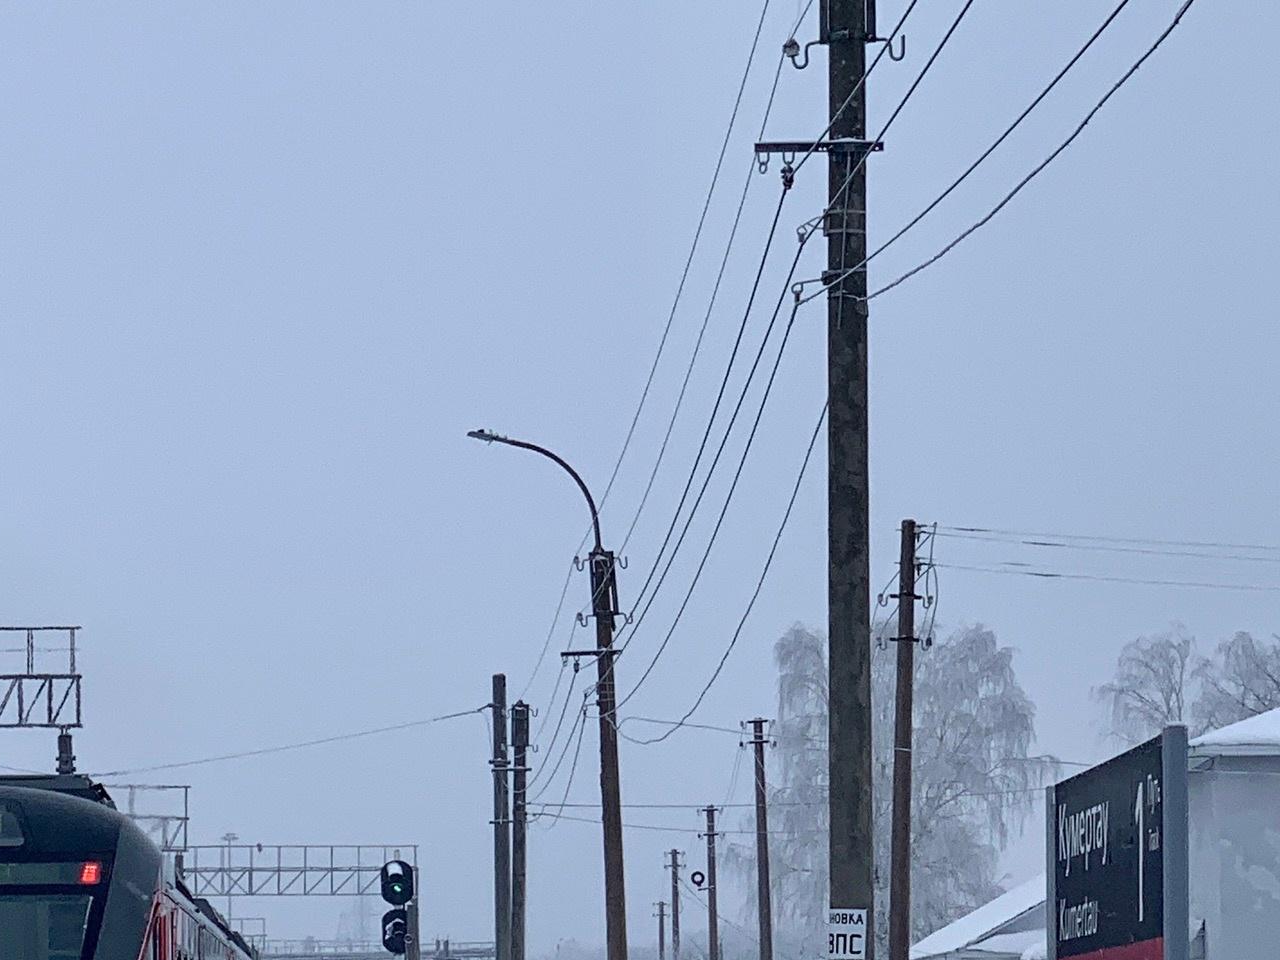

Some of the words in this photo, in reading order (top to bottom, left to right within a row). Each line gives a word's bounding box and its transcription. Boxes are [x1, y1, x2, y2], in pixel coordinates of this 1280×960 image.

[1059, 801, 1108, 876] Кумертау
[1135, 782, 1143, 921] 1
[1059, 896, 1098, 940] Kumertau
